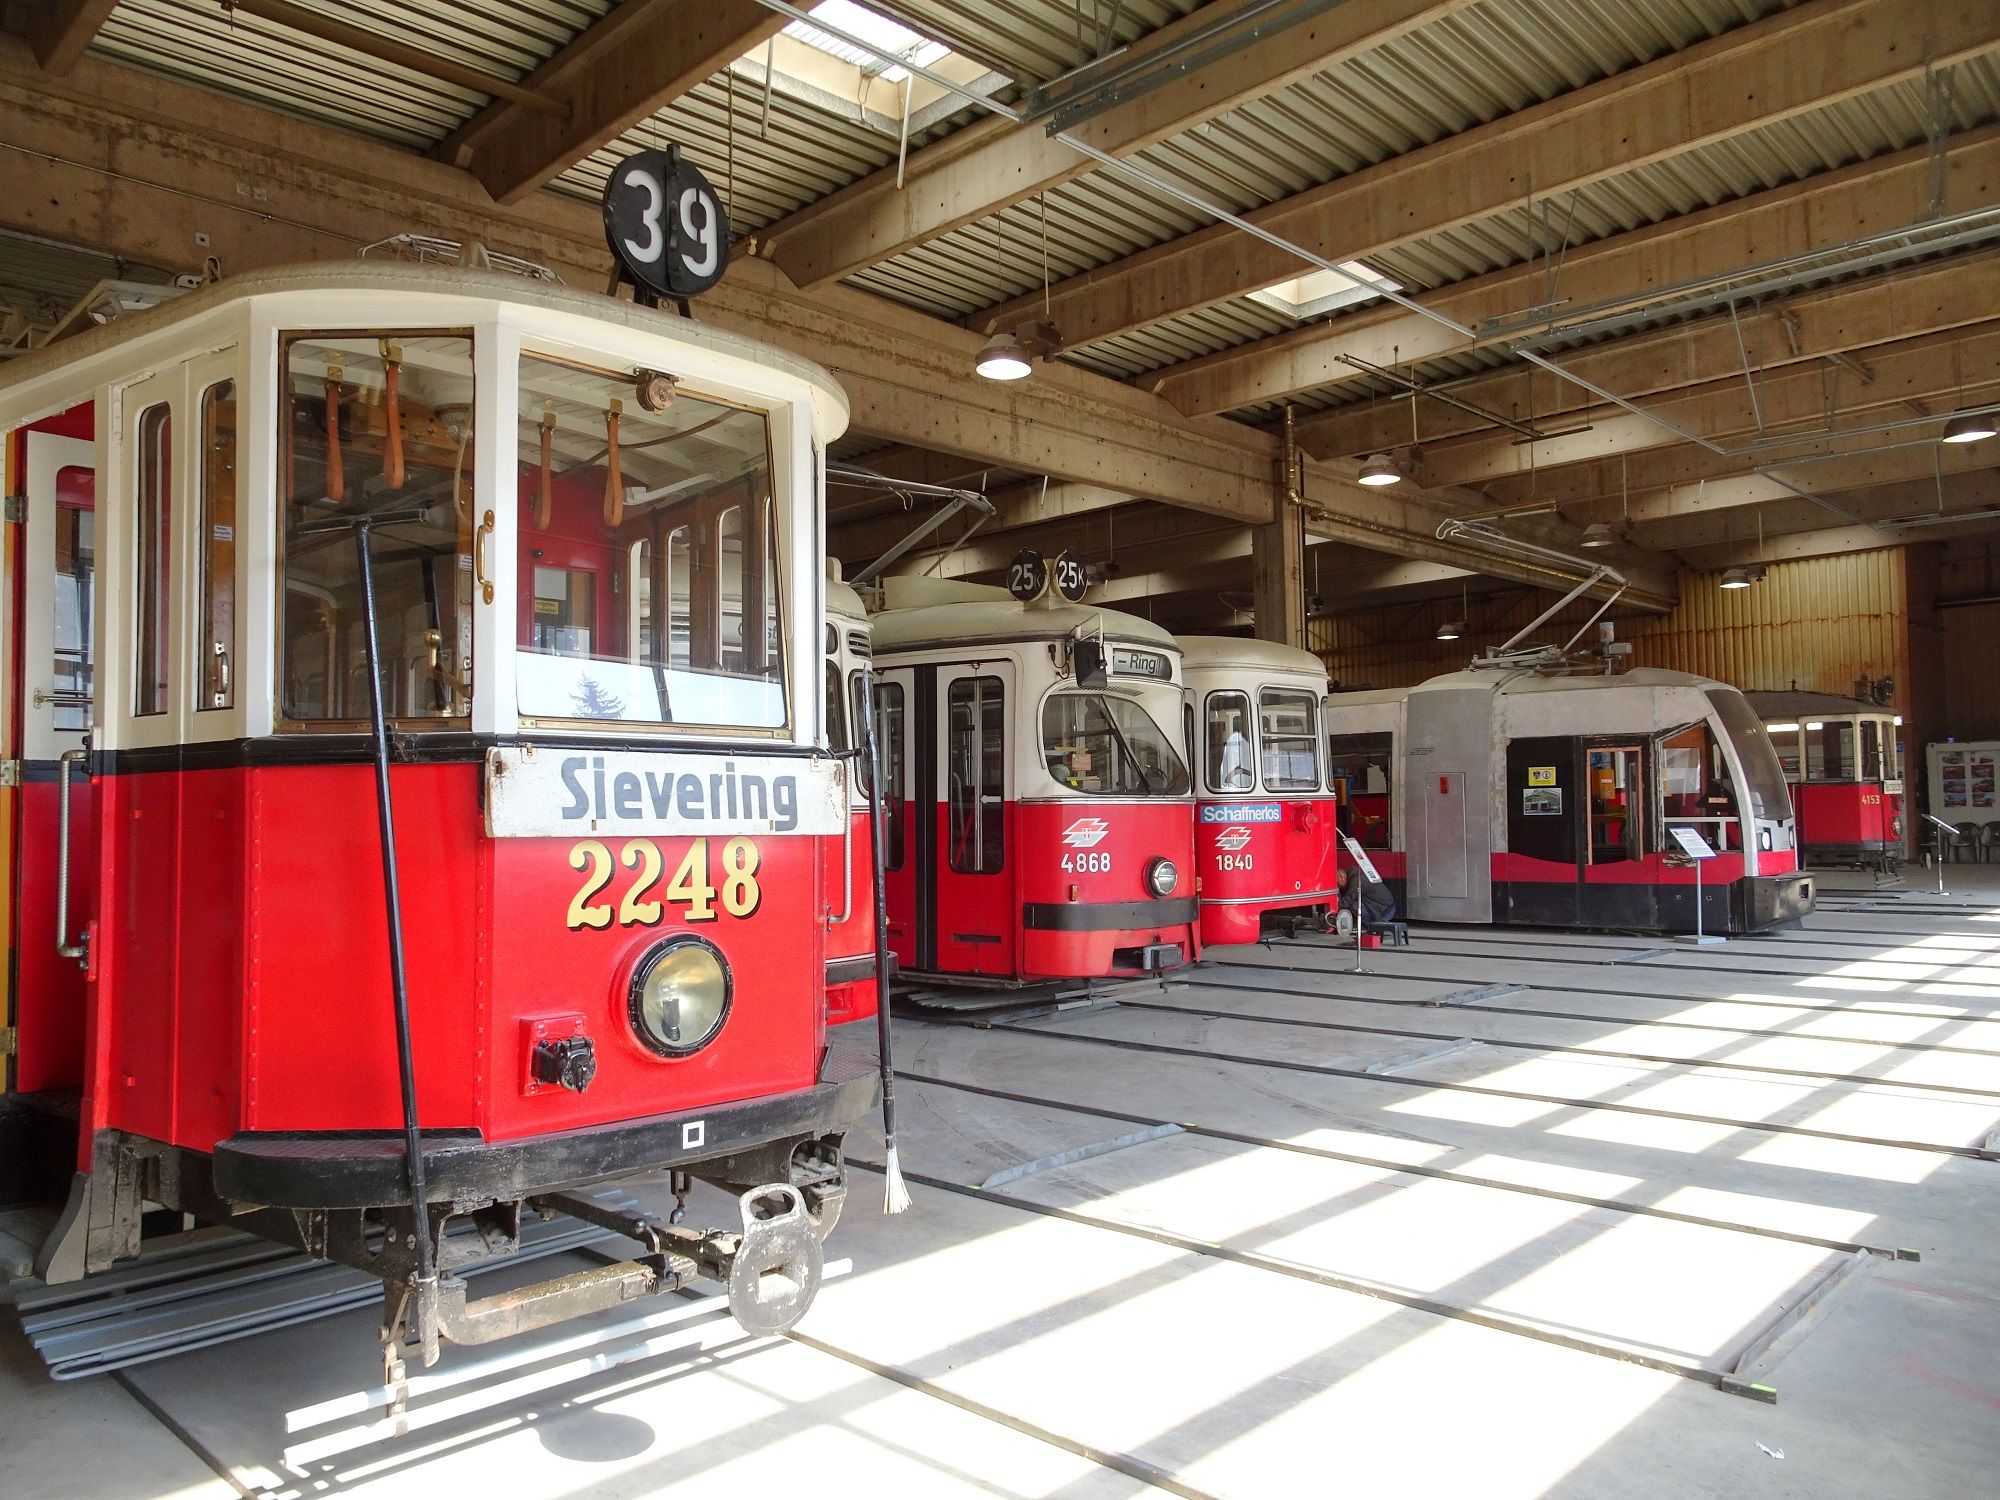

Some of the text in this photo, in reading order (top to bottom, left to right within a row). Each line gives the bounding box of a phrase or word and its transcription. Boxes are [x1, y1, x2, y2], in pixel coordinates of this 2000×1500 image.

[624, 169, 718, 278] 39
[1058, 560, 1085, 589] 25K
[1129, 653, 1156, 674] Ring
[560, 756, 798, 832] Sievering
[1861, 794, 1880, 805] 4153
[1203, 805, 1280, 821] Schaffnerlos
[1060, 852, 1111, 873] 4868
[1215, 853, 1253, 871] 1840
[566, 836, 762, 929] 2248
